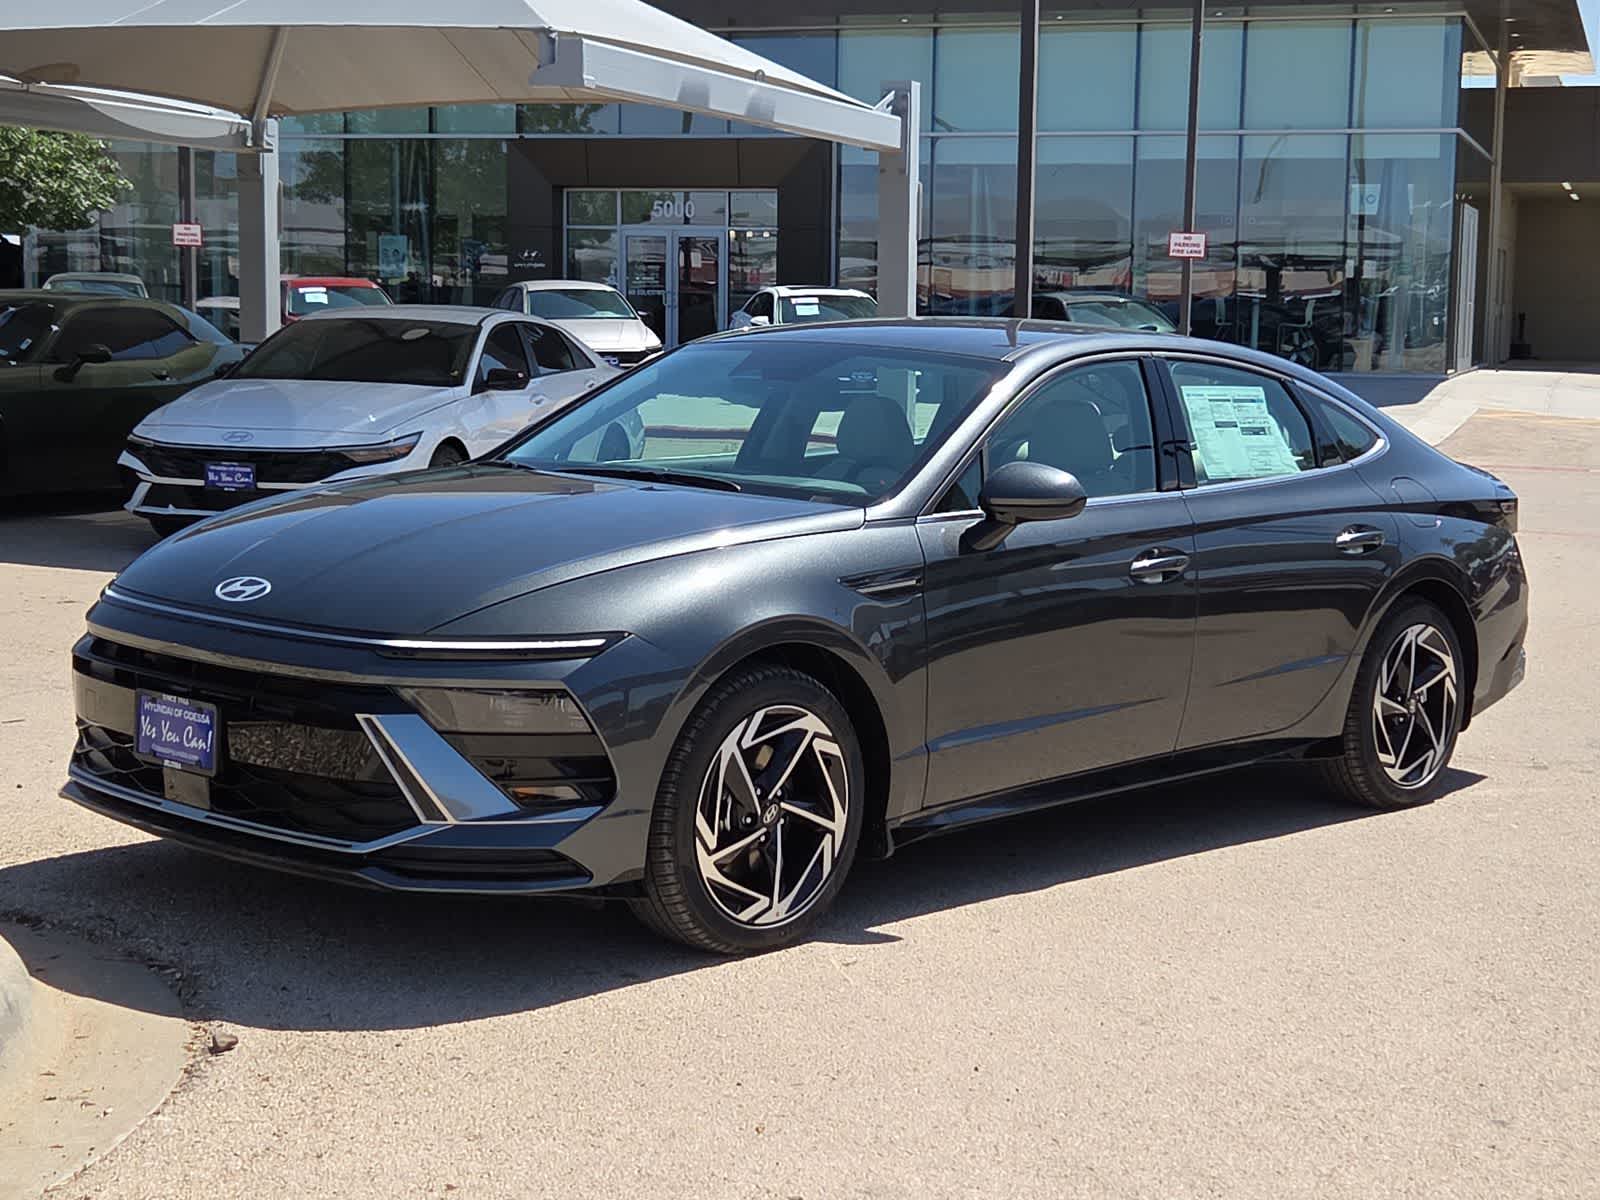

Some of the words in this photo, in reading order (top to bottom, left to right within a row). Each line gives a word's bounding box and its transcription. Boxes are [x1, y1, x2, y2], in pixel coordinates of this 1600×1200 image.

[653, 200, 696, 218] 5000
[144, 702, 174, 716] HYUNDAI
[174, 708, 184, 718] OF
[183, 711, 211, 725] ODESSA
[141, 714, 156, 739] Yes
[161, 719, 180, 743] You
[183, 725, 213, 753] Can!
